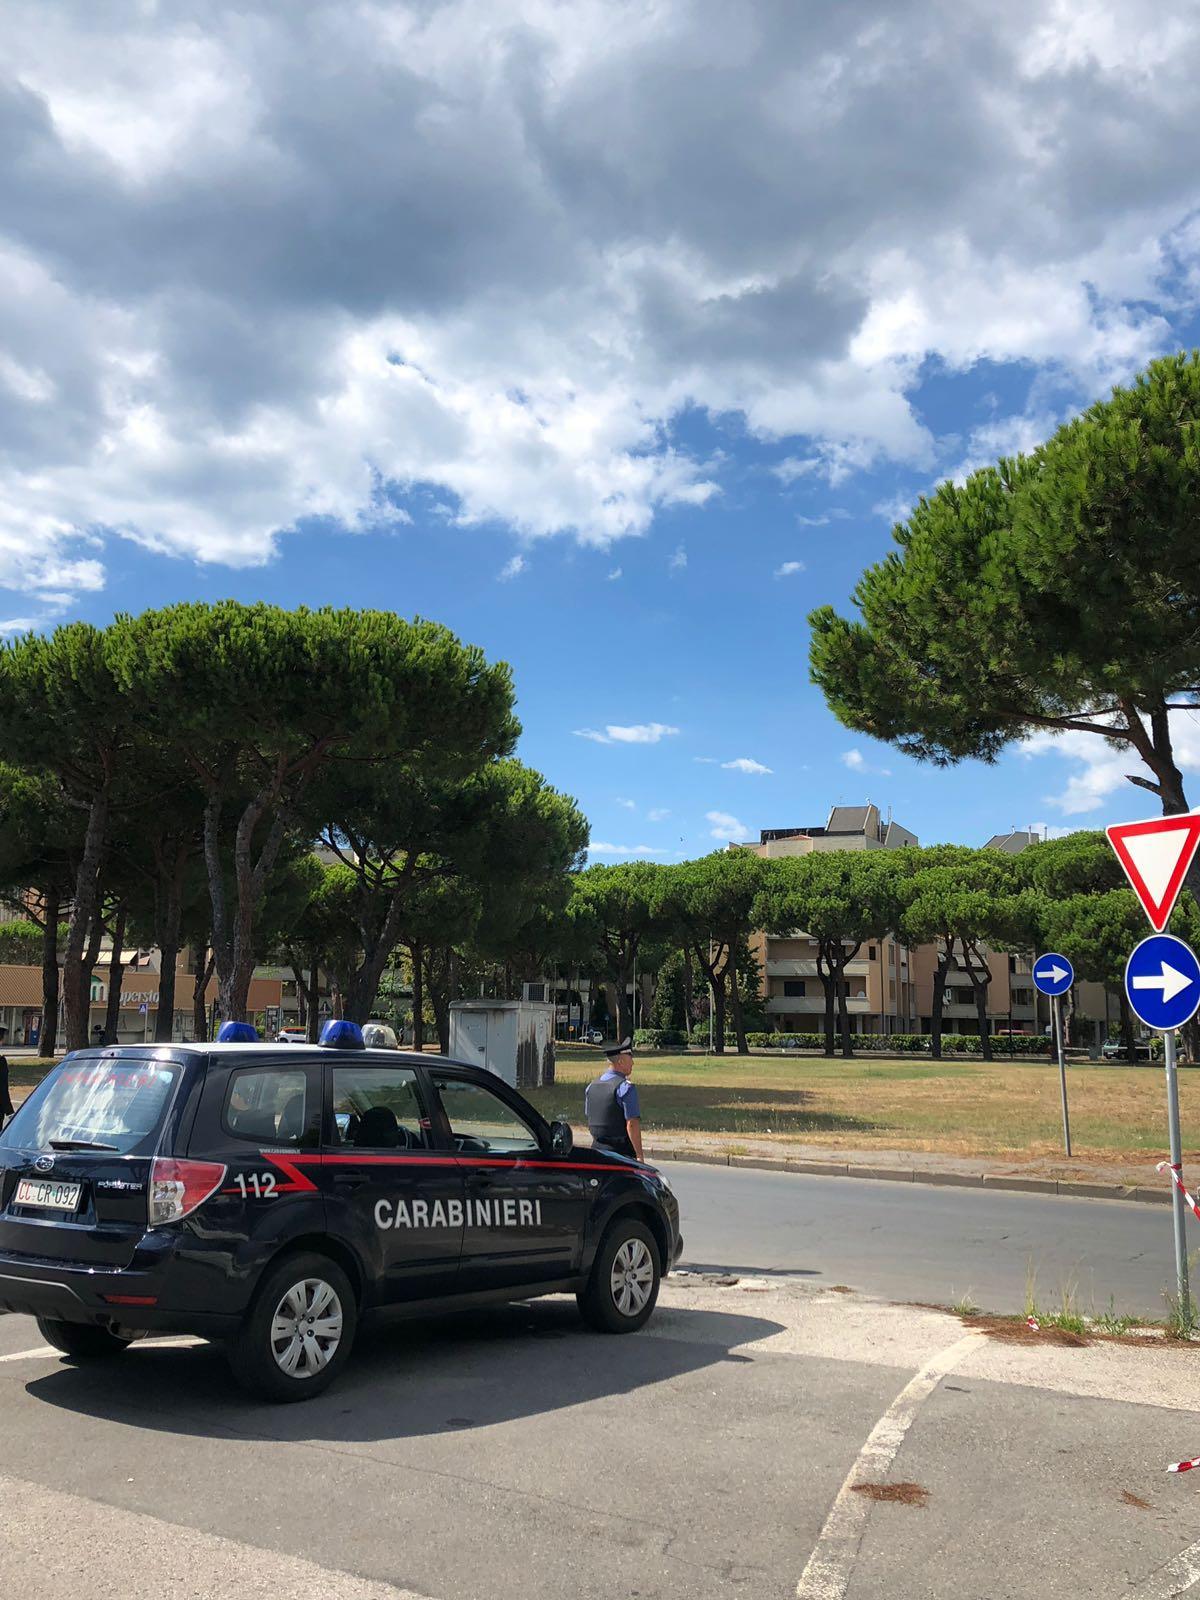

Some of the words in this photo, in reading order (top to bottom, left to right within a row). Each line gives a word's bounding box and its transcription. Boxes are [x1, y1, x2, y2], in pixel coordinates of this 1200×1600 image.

[18, 1182, 34, 1201] CC
[37, 1183, 53, 1204] CR
[54, 1185, 78, 1206] 092
[233, 1172, 279, 1199] 112
[374, 1199, 542, 1230] CARABINIERI
